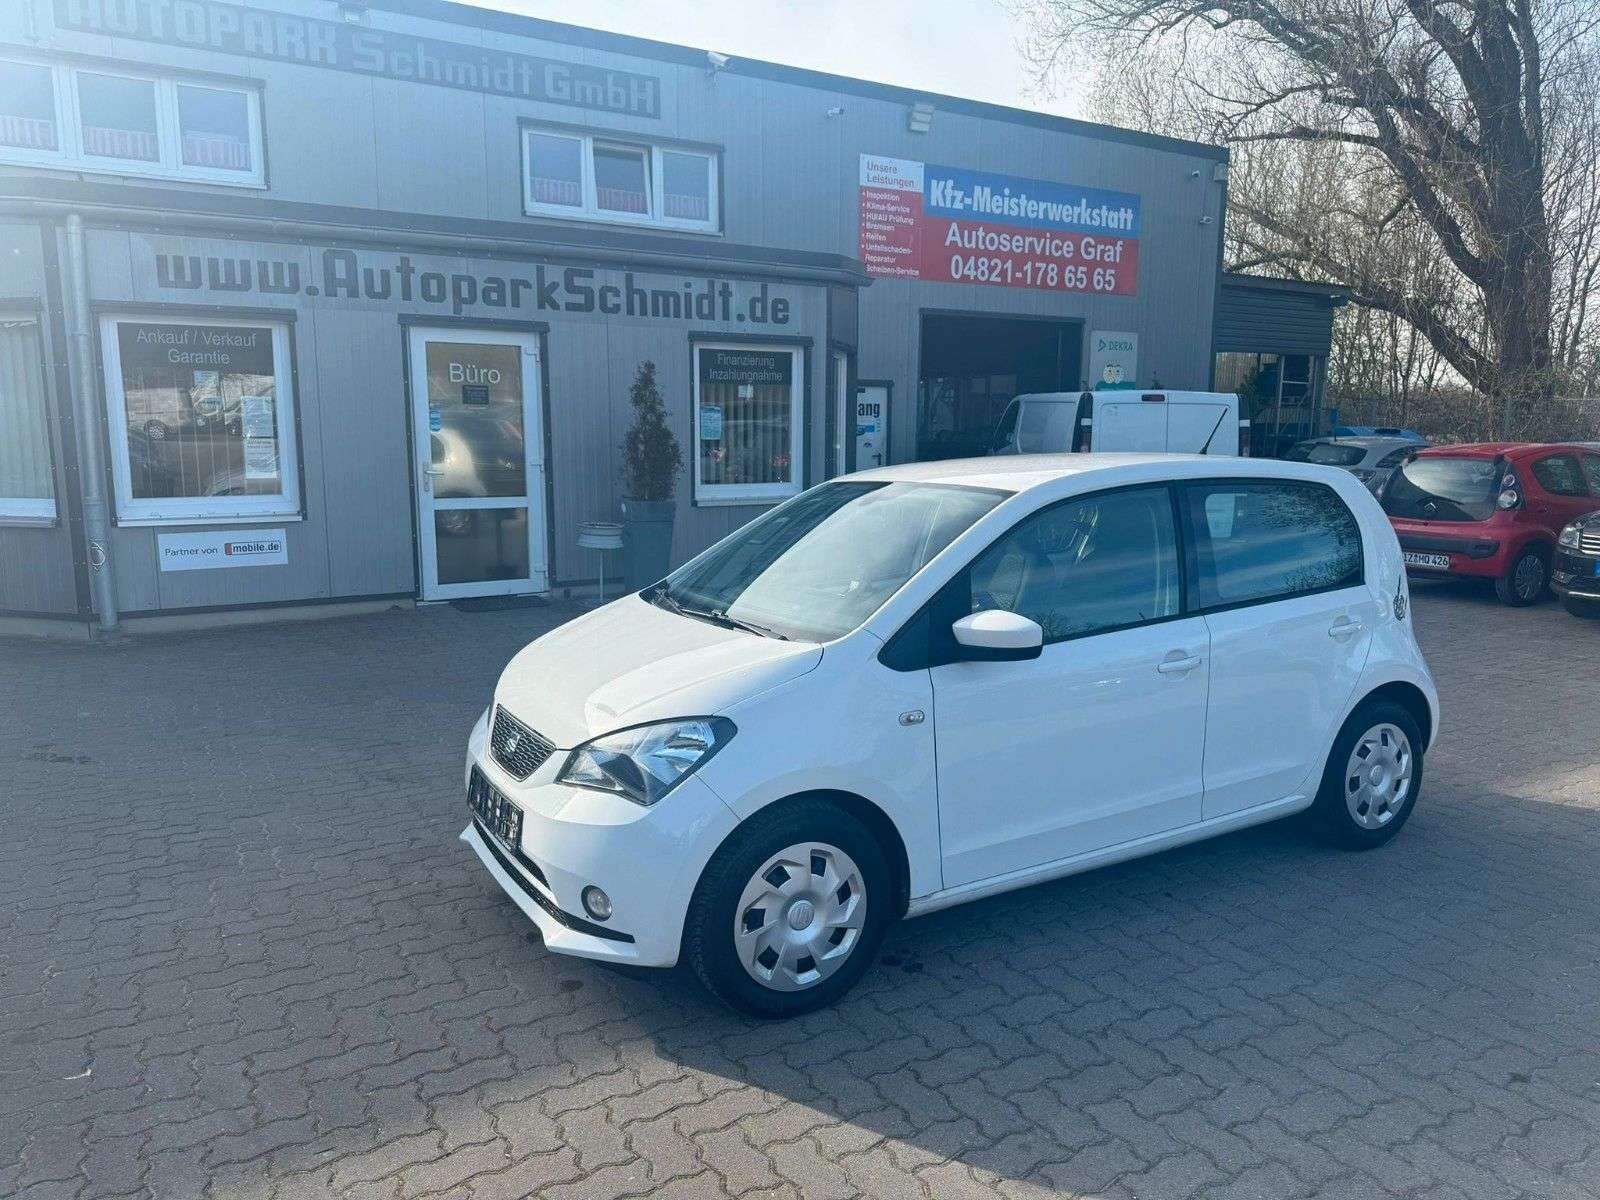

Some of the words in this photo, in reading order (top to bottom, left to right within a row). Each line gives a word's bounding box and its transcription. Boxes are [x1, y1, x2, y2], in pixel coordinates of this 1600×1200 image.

[351, 31, 535, 97] Schmidt
[544, 65, 656, 115] GmbH
[866, 161, 898, 174] Unsere
[866, 174, 915, 188] Leistungen
[866, 190, 900, 201] Inspektion
[930, 179, 1133, 230] Kfz-Meisterwerkstatt
[944, 221, 1074, 257] Autoservice
[1080, 237, 1123, 263] Graf
[951, 254, 1058, 287] 04821-178
[1064, 264, 1087, 289] 65
[1093, 267, 1116, 291] 65
[156, 249, 790, 325] www.AutoparkSchmidt.de
[136, 328, 190, 345] Ankauf
[202, 331, 257, 348] Verkauf
[168, 349, 231, 364] Garantie
[717, 353, 775, 369] Finanzierung
[449, 363, 501, 384] Büro
[709, 368, 783, 383] Inzahlungnahme
[164, 547, 199, 556] Partner
[201, 547, 218, 556] von
[233, 541, 279, 553] mobile.de
[1432, 556, 1448, 566] 426
